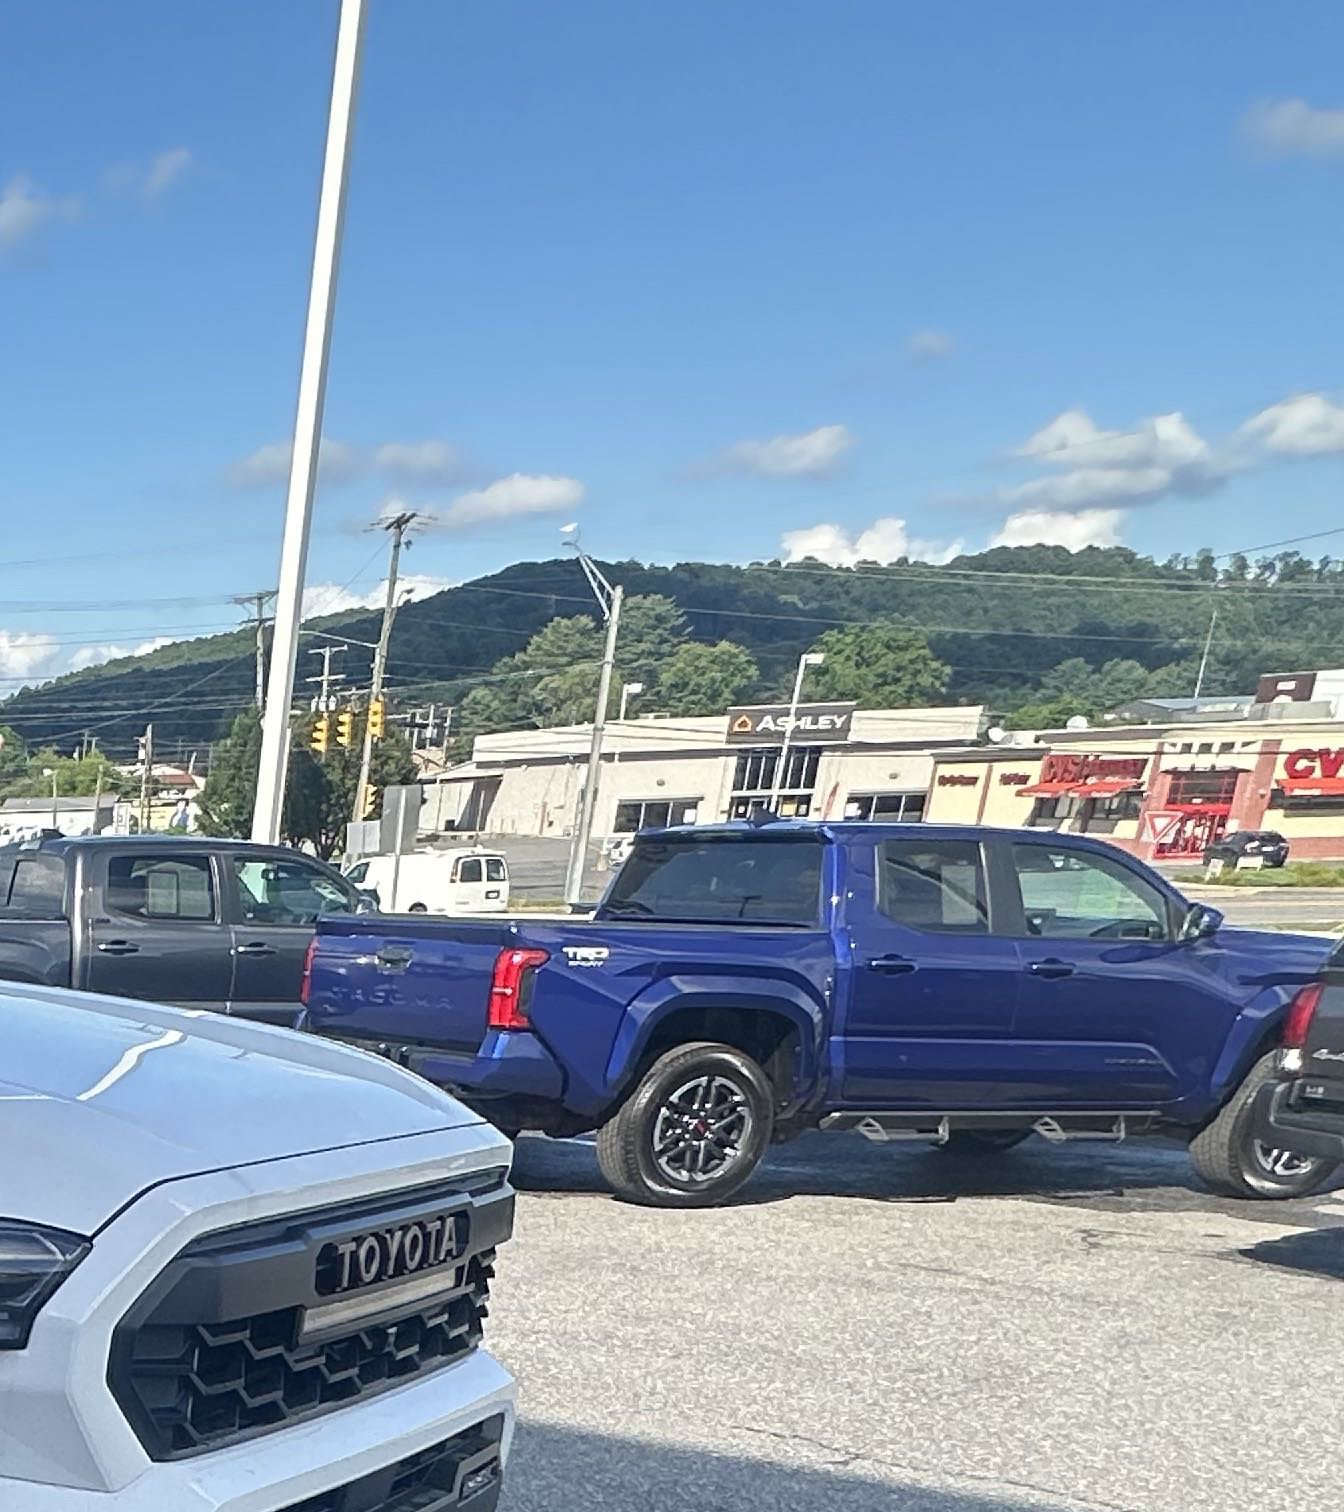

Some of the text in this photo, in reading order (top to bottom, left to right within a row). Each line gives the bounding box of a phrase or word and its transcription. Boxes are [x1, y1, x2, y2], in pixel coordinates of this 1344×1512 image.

[755, 714, 848, 732] ASHLEY
[562, 946, 610, 960] TRD
[337, 1216, 458, 1290] TOYOTA
